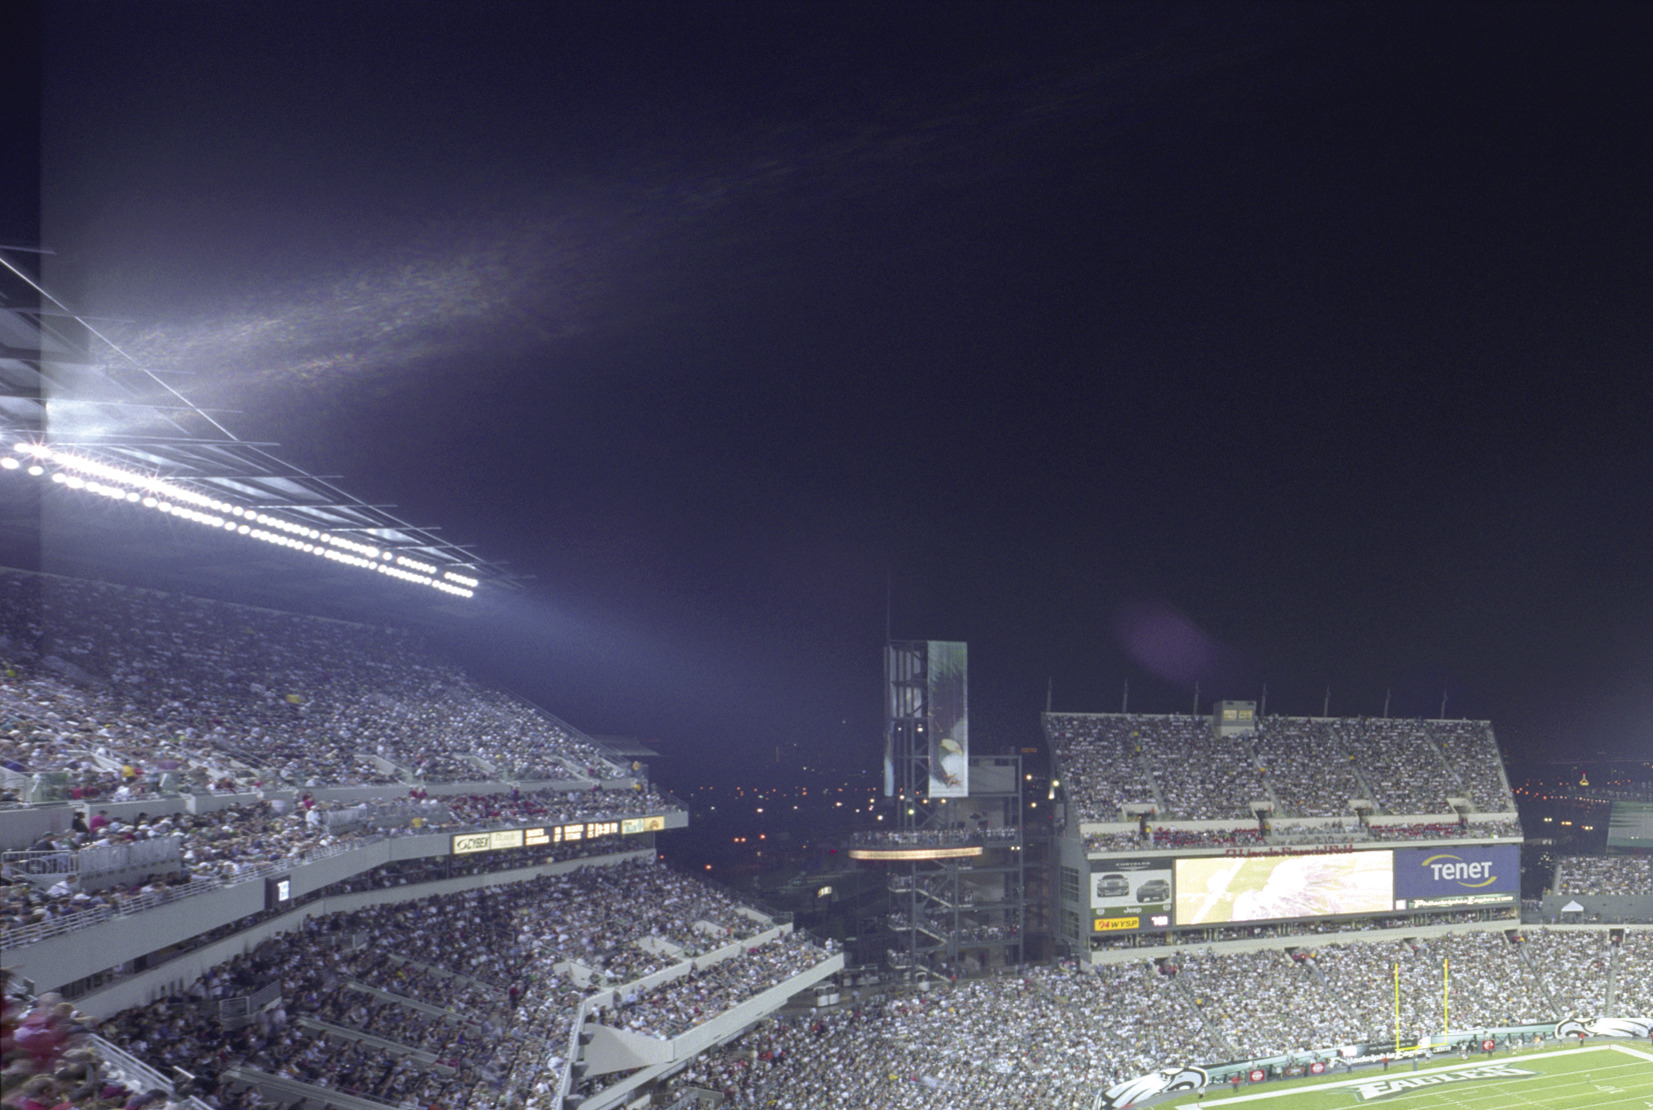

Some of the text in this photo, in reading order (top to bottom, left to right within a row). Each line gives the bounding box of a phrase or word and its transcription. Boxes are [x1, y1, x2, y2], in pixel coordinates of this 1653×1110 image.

[1240, 843, 1353, 858] Lincoln Financial Field
[1123, 906, 1142, 914] Jeep
[1098, 920, 1138, 929] 94 WYSP
[1354, 1064, 1537, 1100] EAGLES
